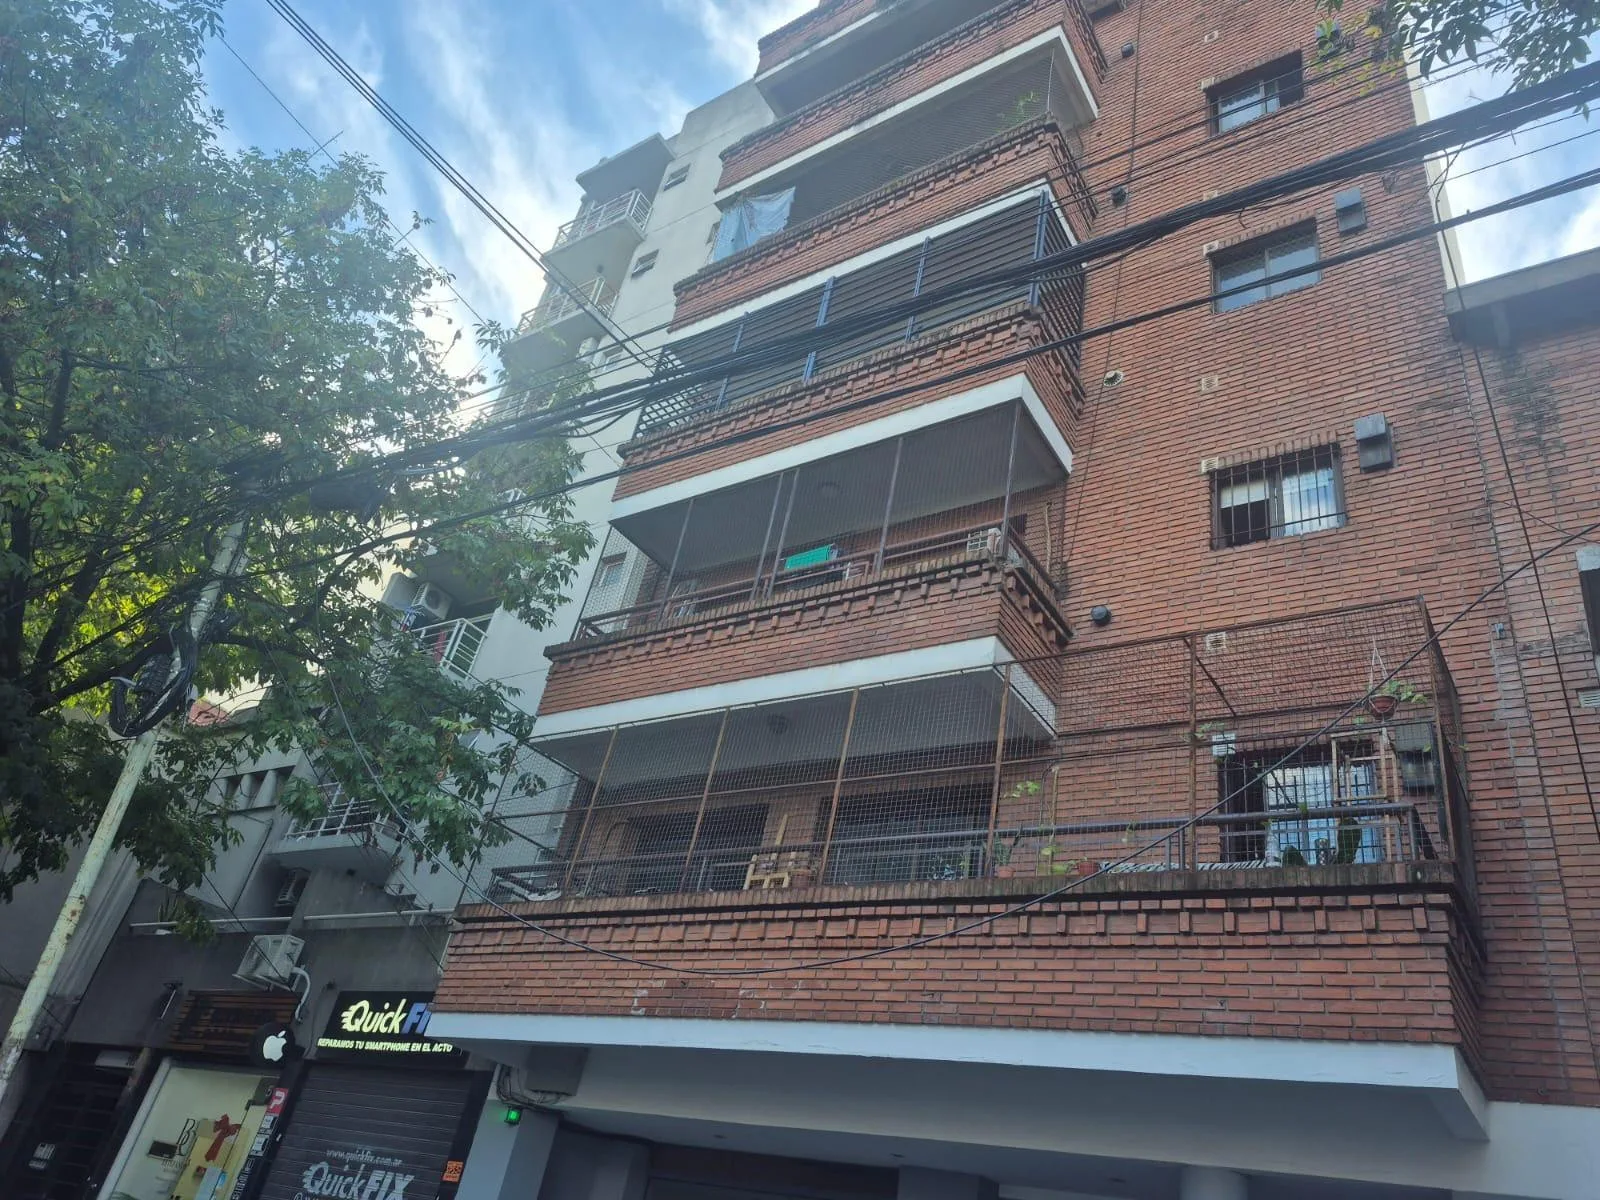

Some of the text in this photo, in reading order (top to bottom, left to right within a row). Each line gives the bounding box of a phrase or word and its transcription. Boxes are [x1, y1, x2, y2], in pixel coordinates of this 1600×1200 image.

[317, 1038, 453, 1053] REPARAMOS TU SMARTPHONE EN EL ACTO
[302, 1161, 414, 1200] QuickFIX
